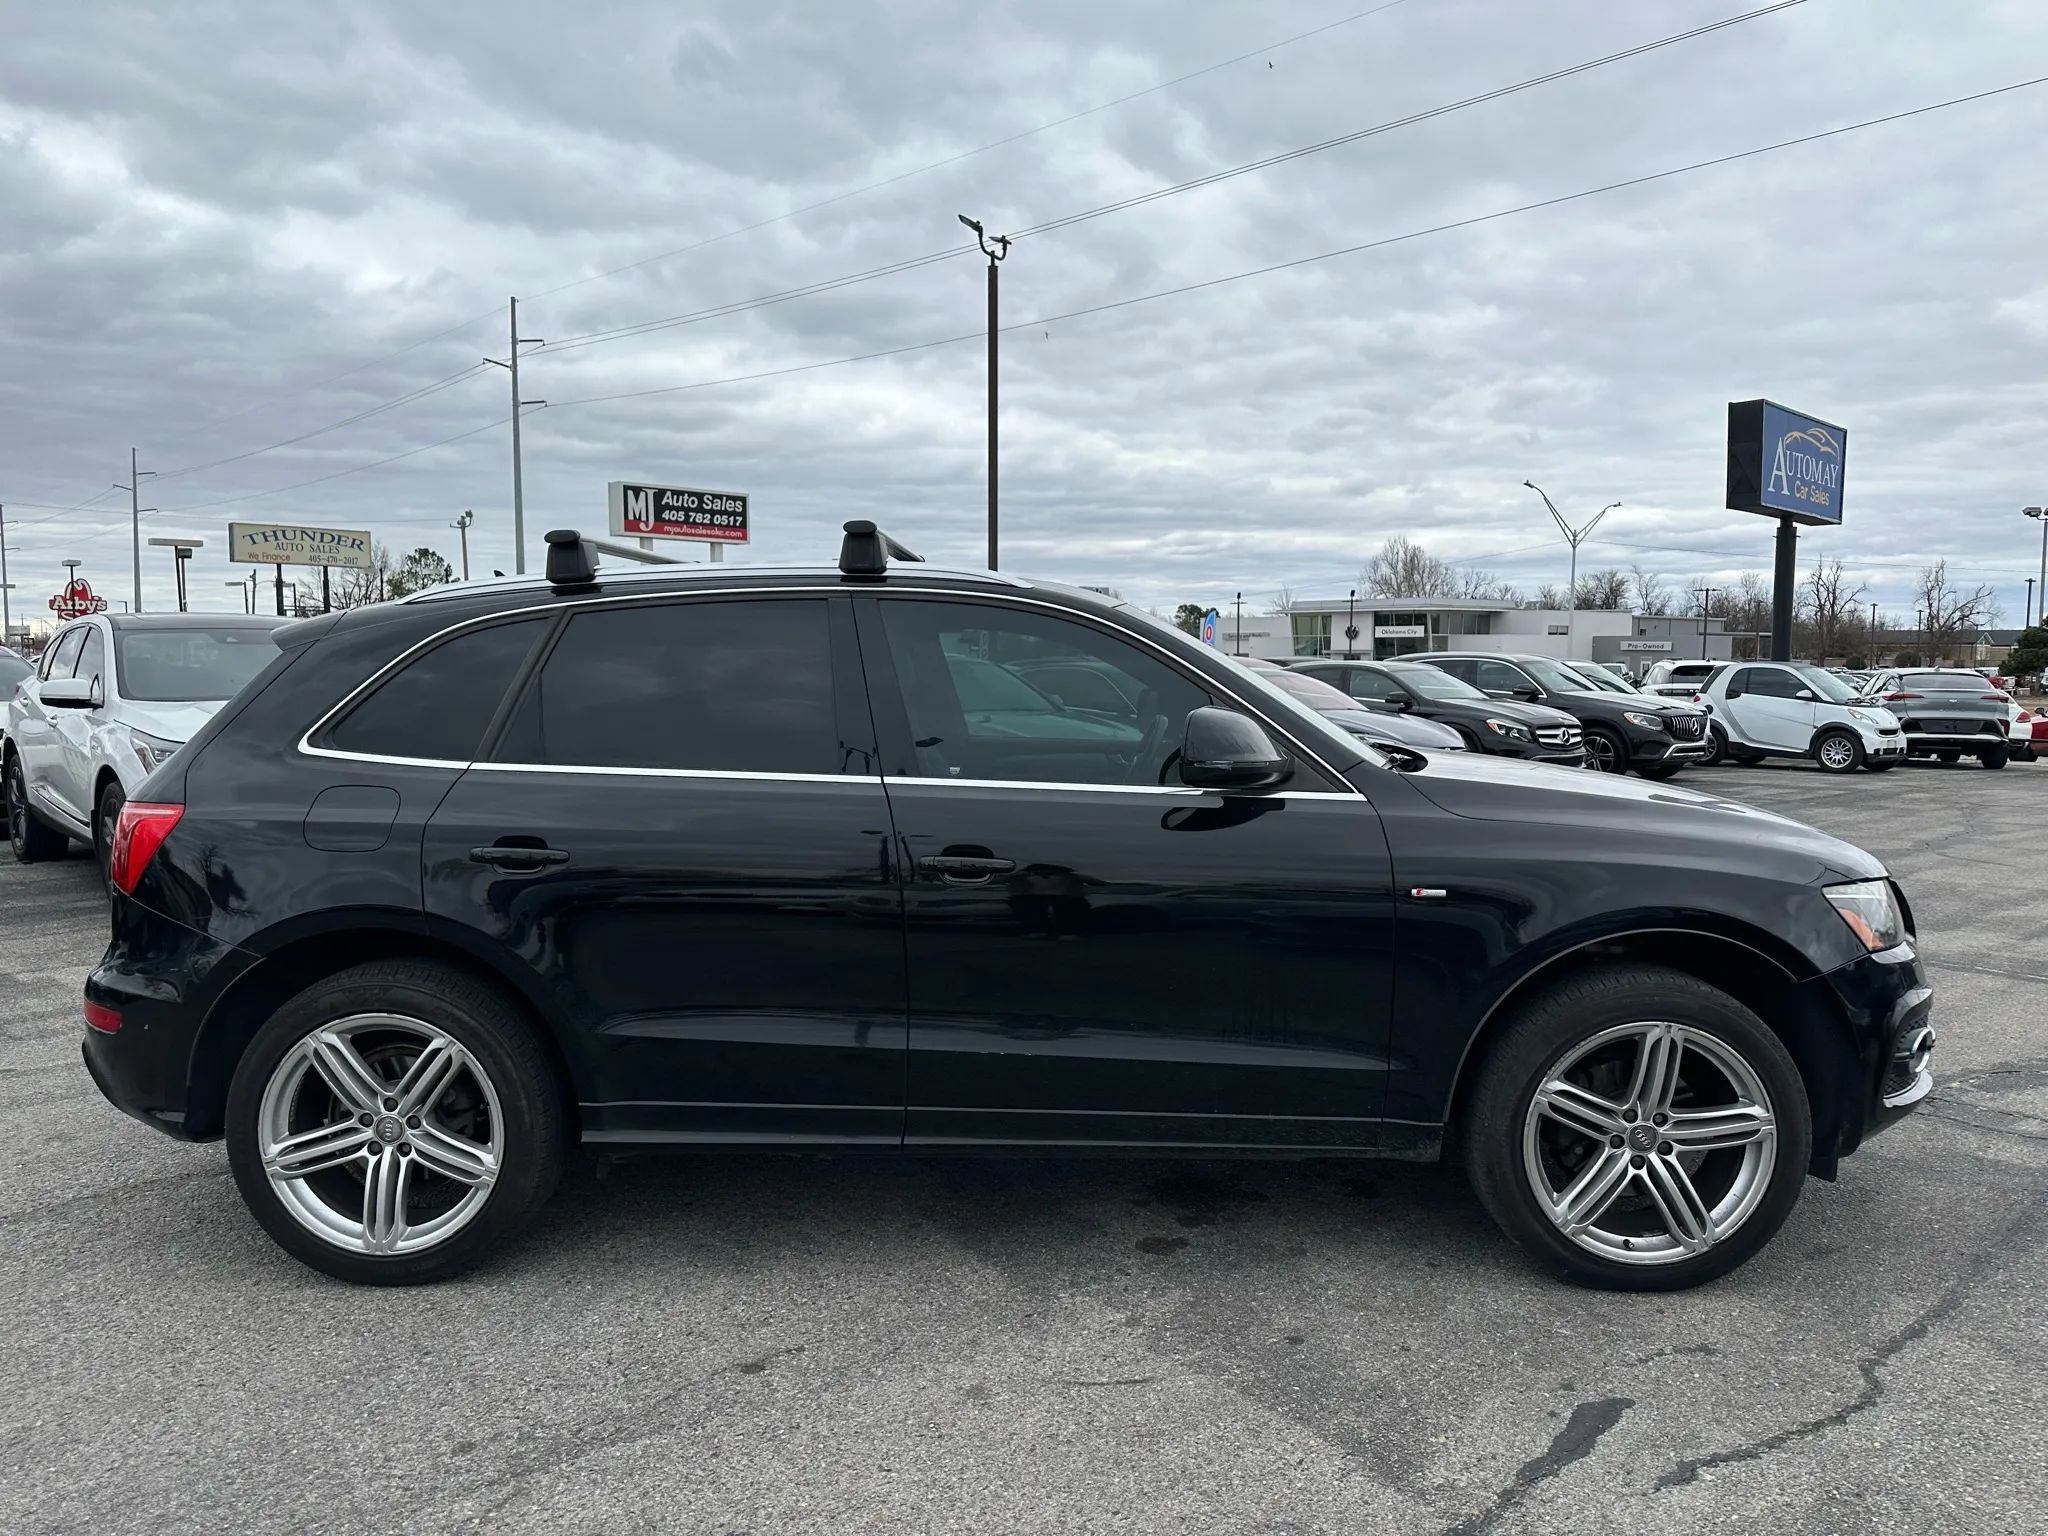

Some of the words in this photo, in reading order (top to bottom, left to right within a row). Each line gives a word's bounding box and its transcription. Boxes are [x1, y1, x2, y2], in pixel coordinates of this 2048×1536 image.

[1768, 437, 1839, 495] AUTOMAY
[661, 491, 698, 508] Auto
[702, 495, 743, 512] Sales
[1794, 481, 1808, 500] Car
[1810, 485, 1830, 506] Sales
[627, 488, 658, 531] MJ
[662, 510, 685, 521] 405
[688, 512, 711, 524] 782
[713, 515, 743, 526] 0517
[242, 529, 364, 552] THUNDER
[275, 542, 304, 552] AUTO
[309, 544, 340, 554] SALES
[248, 551, 259, 560] We
[262, 552, 291, 561] Finance
[53, 596, 106, 613] Arby's
